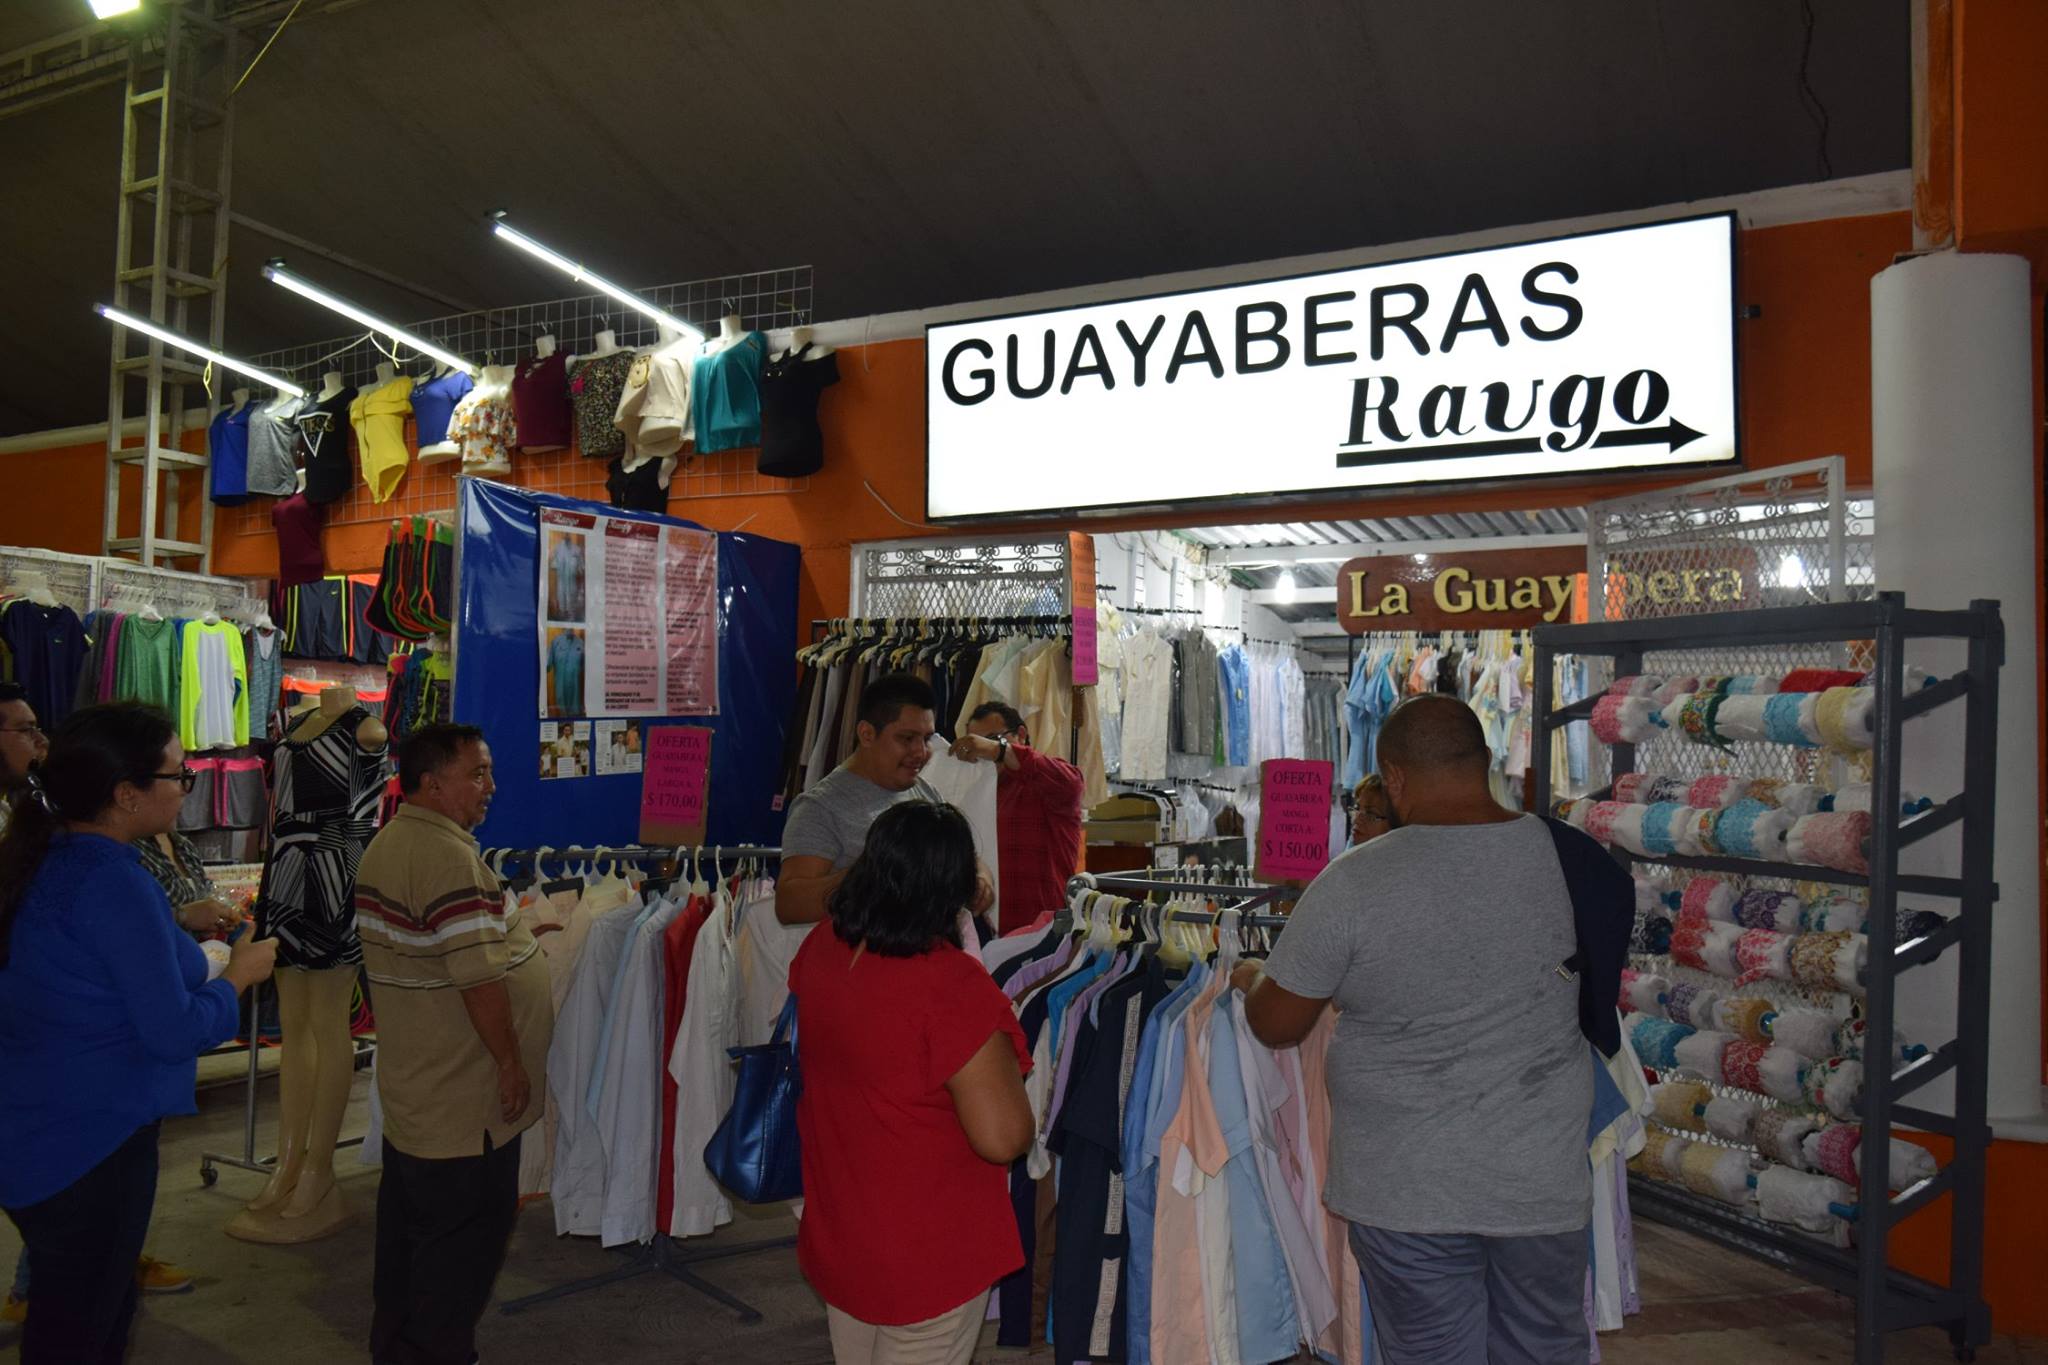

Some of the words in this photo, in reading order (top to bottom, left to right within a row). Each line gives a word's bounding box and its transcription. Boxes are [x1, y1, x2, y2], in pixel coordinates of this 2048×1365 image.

[942, 261, 1584, 406] GUAYABERAS
[1338, 368, 1671, 453] Raugo
[1347, 570, 1410, 616] La
[1433, 561, 1743, 623] Guaybera
[657, 735, 700, 748] OFERTA
[652, 752, 703, 762] GUAYABERA
[1272, 770, 1322, 785] OFERTA
[1270, 792, 1323, 804] GUAYABERA
[1281, 810, 1310, 818] MANGA
[1275, 823, 1304, 833] CORTA
[1264, 840, 1273, 857] $
[1278, 841, 1323, 861] 150.00
